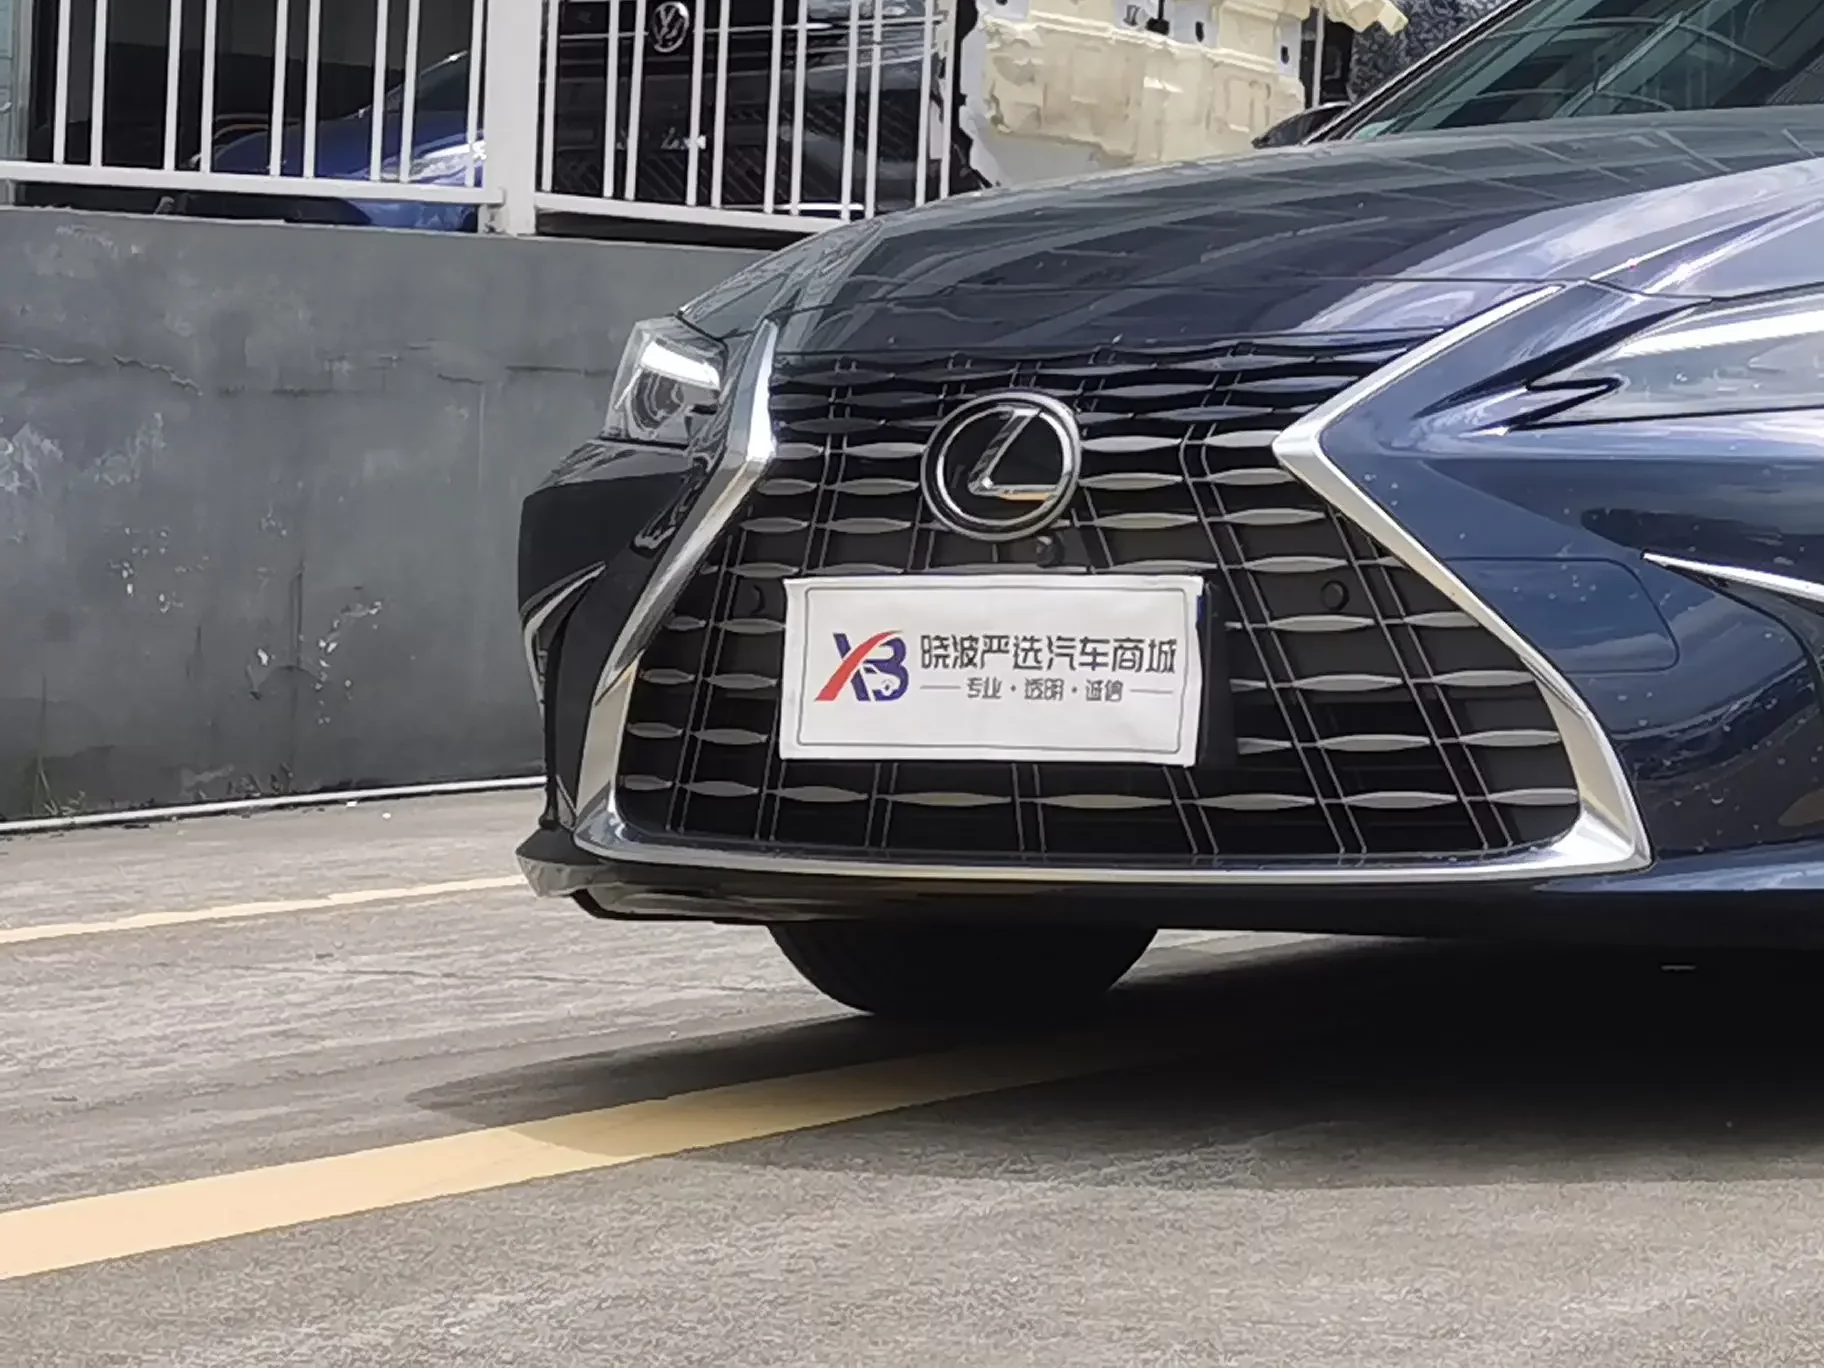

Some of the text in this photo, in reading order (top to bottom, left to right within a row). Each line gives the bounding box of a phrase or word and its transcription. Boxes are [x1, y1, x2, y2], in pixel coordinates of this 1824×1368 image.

[920, 633, 1178, 674] 晓波严选汽车商城
